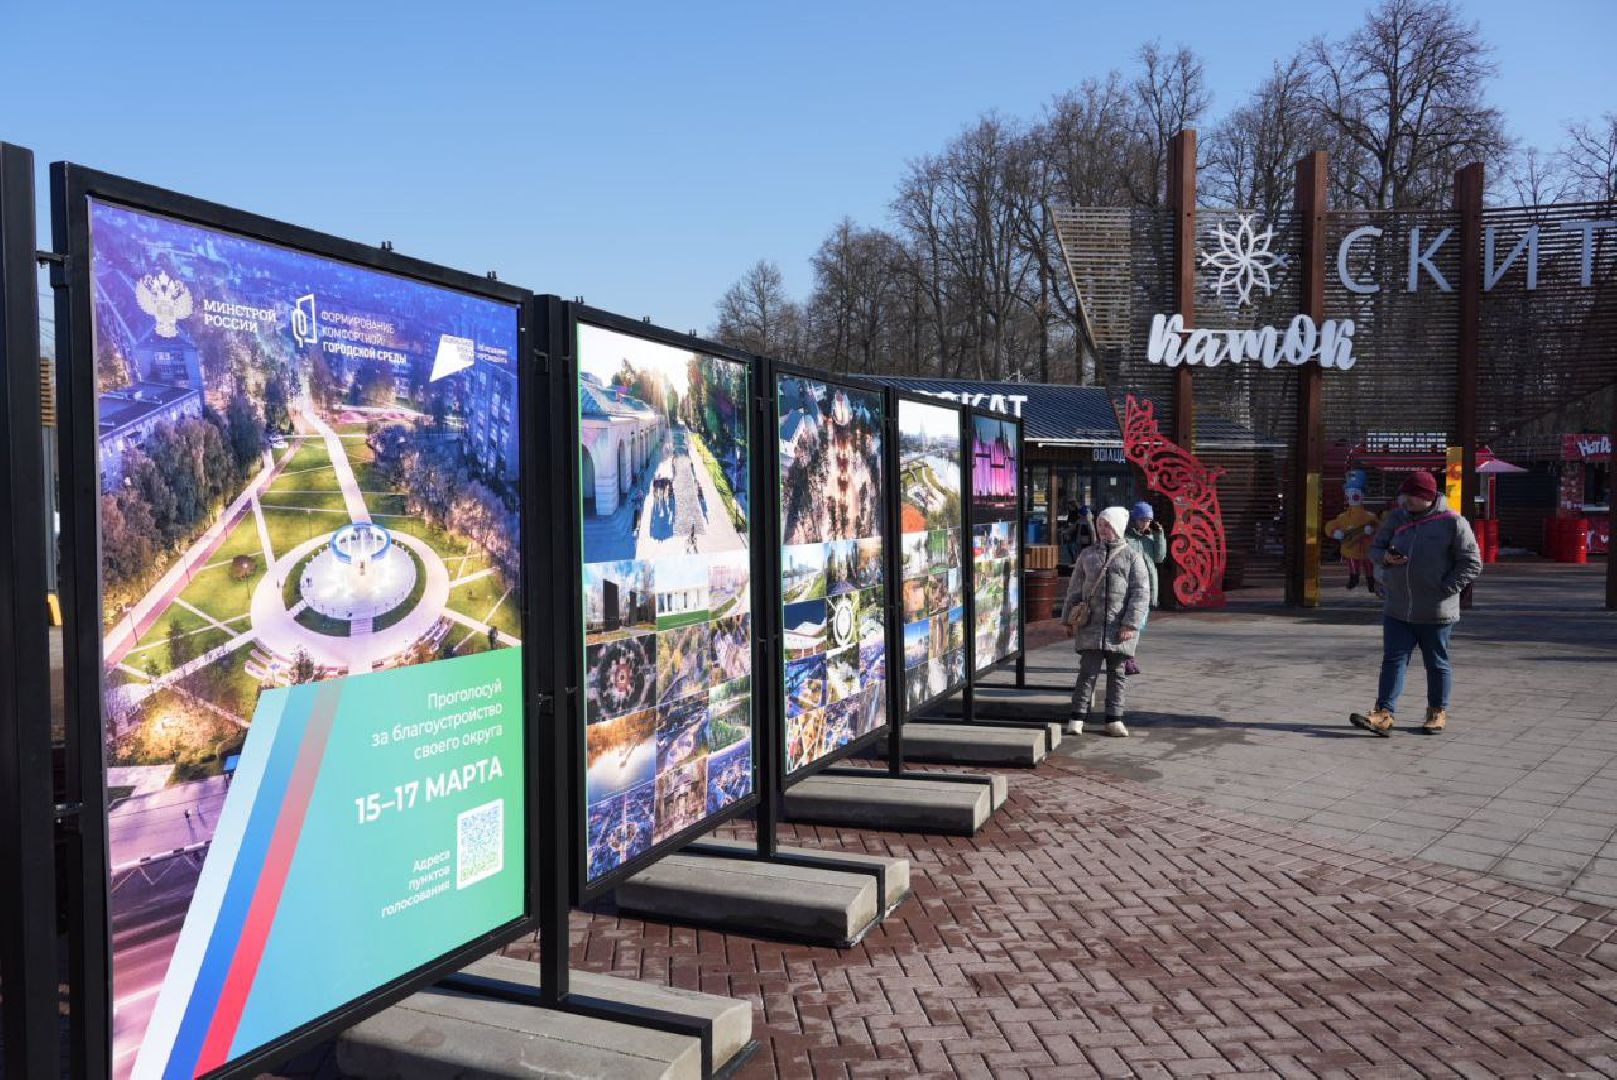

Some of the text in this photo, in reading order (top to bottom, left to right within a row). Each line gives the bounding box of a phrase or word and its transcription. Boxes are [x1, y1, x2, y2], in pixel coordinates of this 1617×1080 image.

[203, 299, 277, 323] МИНСТРОЙ
[204, 313, 258, 333] РОССИИ
[323, 341, 407, 364] ГОРОДСКОЙ СРЕДЫ
[428, 678, 503, 710] Проголосуй
[371, 702, 503, 747] за благоустройство
[414, 724, 503, 761] своего округа
[425, 755, 503, 802] МАРТА
[413, 849, 451, 873] Адреса
[408, 864, 451, 891] пунктов
[381, 880, 451, 919] голосования
